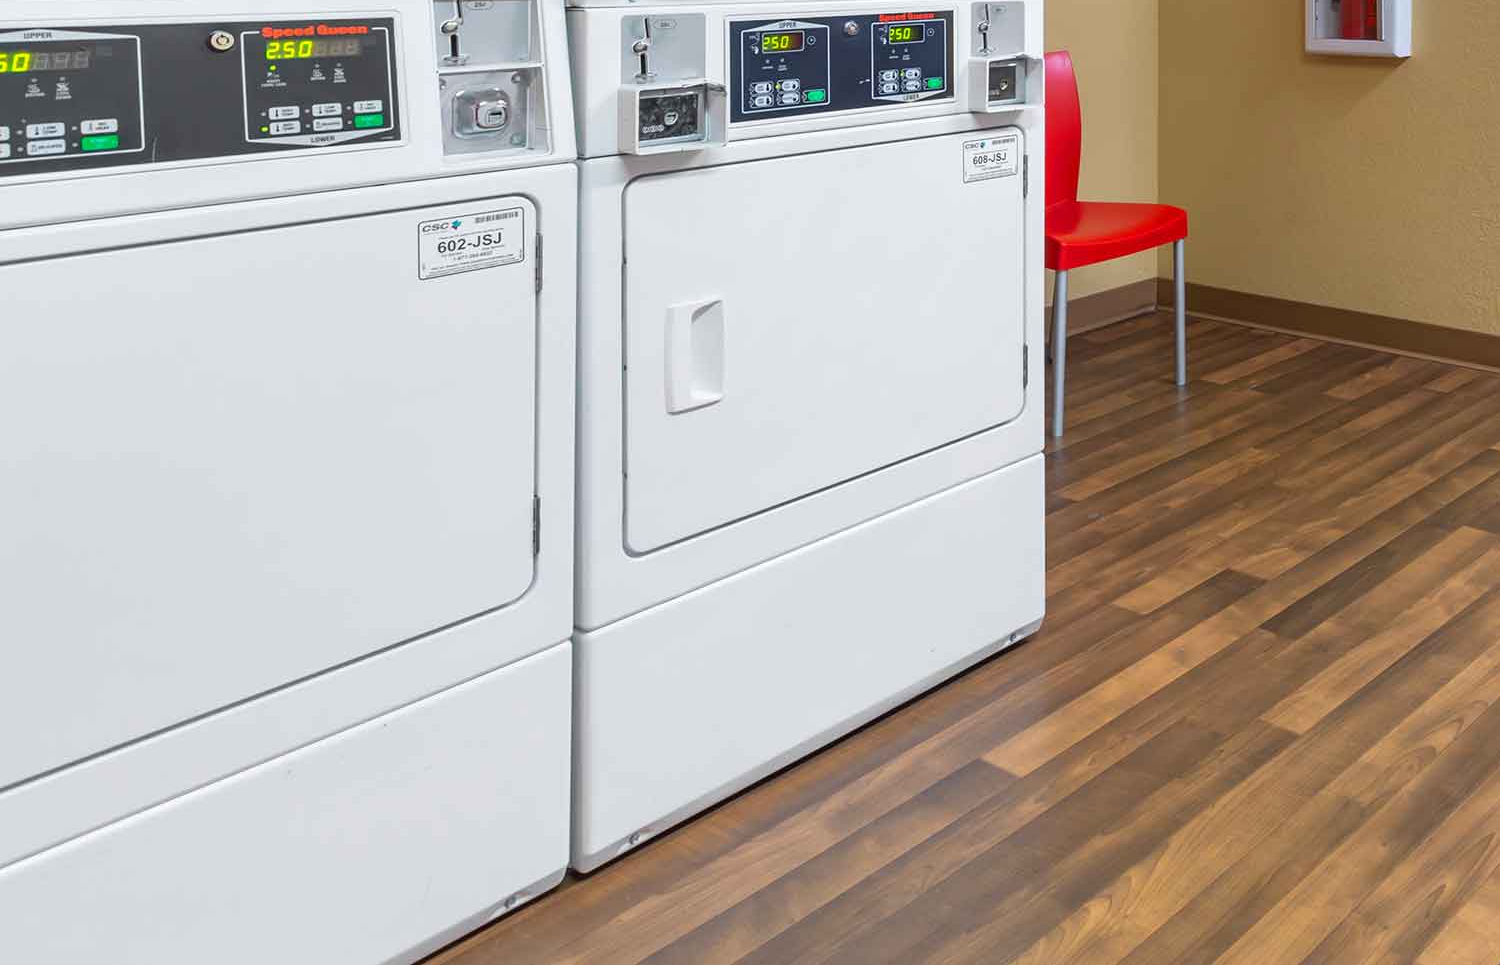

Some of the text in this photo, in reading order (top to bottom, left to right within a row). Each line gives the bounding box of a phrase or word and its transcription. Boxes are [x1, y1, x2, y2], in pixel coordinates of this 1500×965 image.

[23, 32, 53, 40] UPPER
[262, 23, 368, 38] Speed Queen
[311, 135, 335, 144] LOWER
[973, 152, 1007, 165] 608-JSJ
[422, 222, 449, 233] CSC
[438, 232, 502, 253] 602-JSJ
